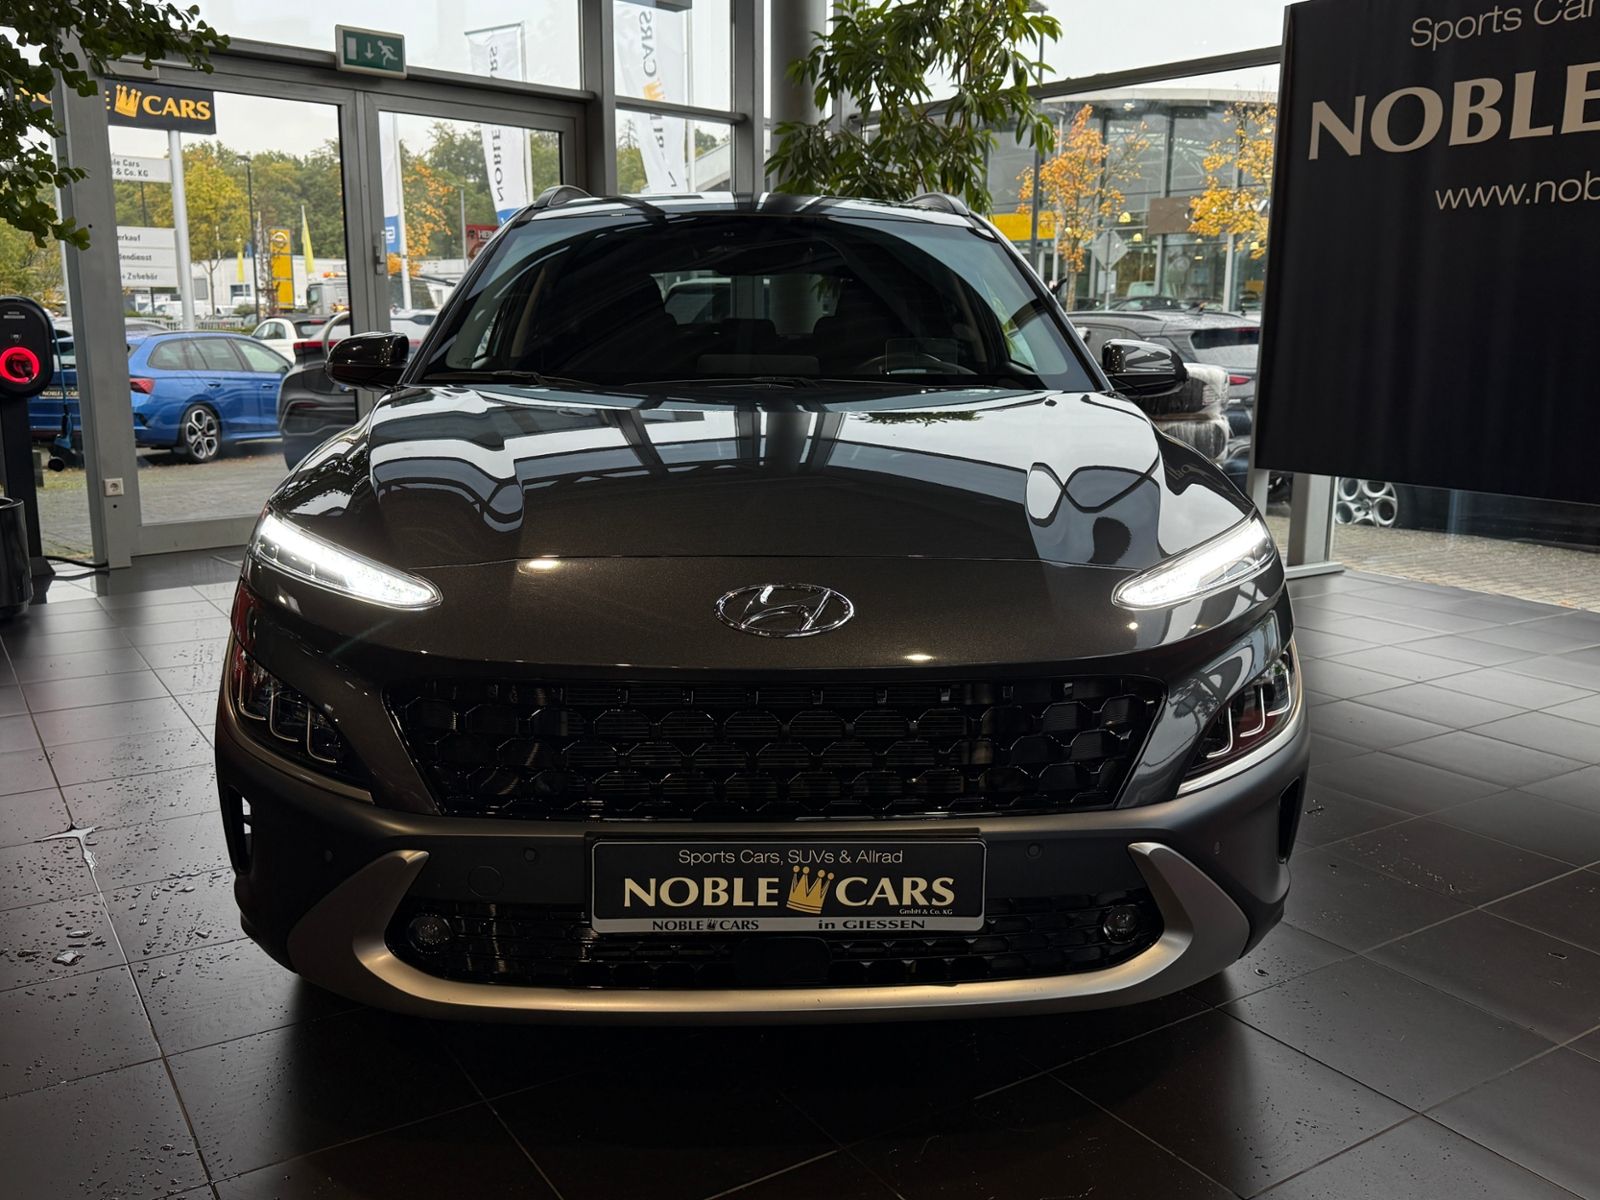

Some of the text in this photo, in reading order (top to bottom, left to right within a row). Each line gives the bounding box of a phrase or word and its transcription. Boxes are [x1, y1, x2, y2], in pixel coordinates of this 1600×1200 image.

[1410, 0, 1600, 51] Sports Car
[142, 95, 211, 121] CARS
[1308, 61, 1600, 161] NOBLE
[123, 159, 140, 168] Cars
[138, 169, 149, 178] KG
[1434, 170, 1600, 211] www.nob
[117, 233, 141, 242] erkauf
[678, 849, 904, 866] Sports Cars, SUVs & Allrad
[623, 876, 955, 908] NOBLE CARS
[899, 908, 953, 916] GmbH & Co. KG
[652, 918, 925, 931] NOBLE CARS in GIESSEN
